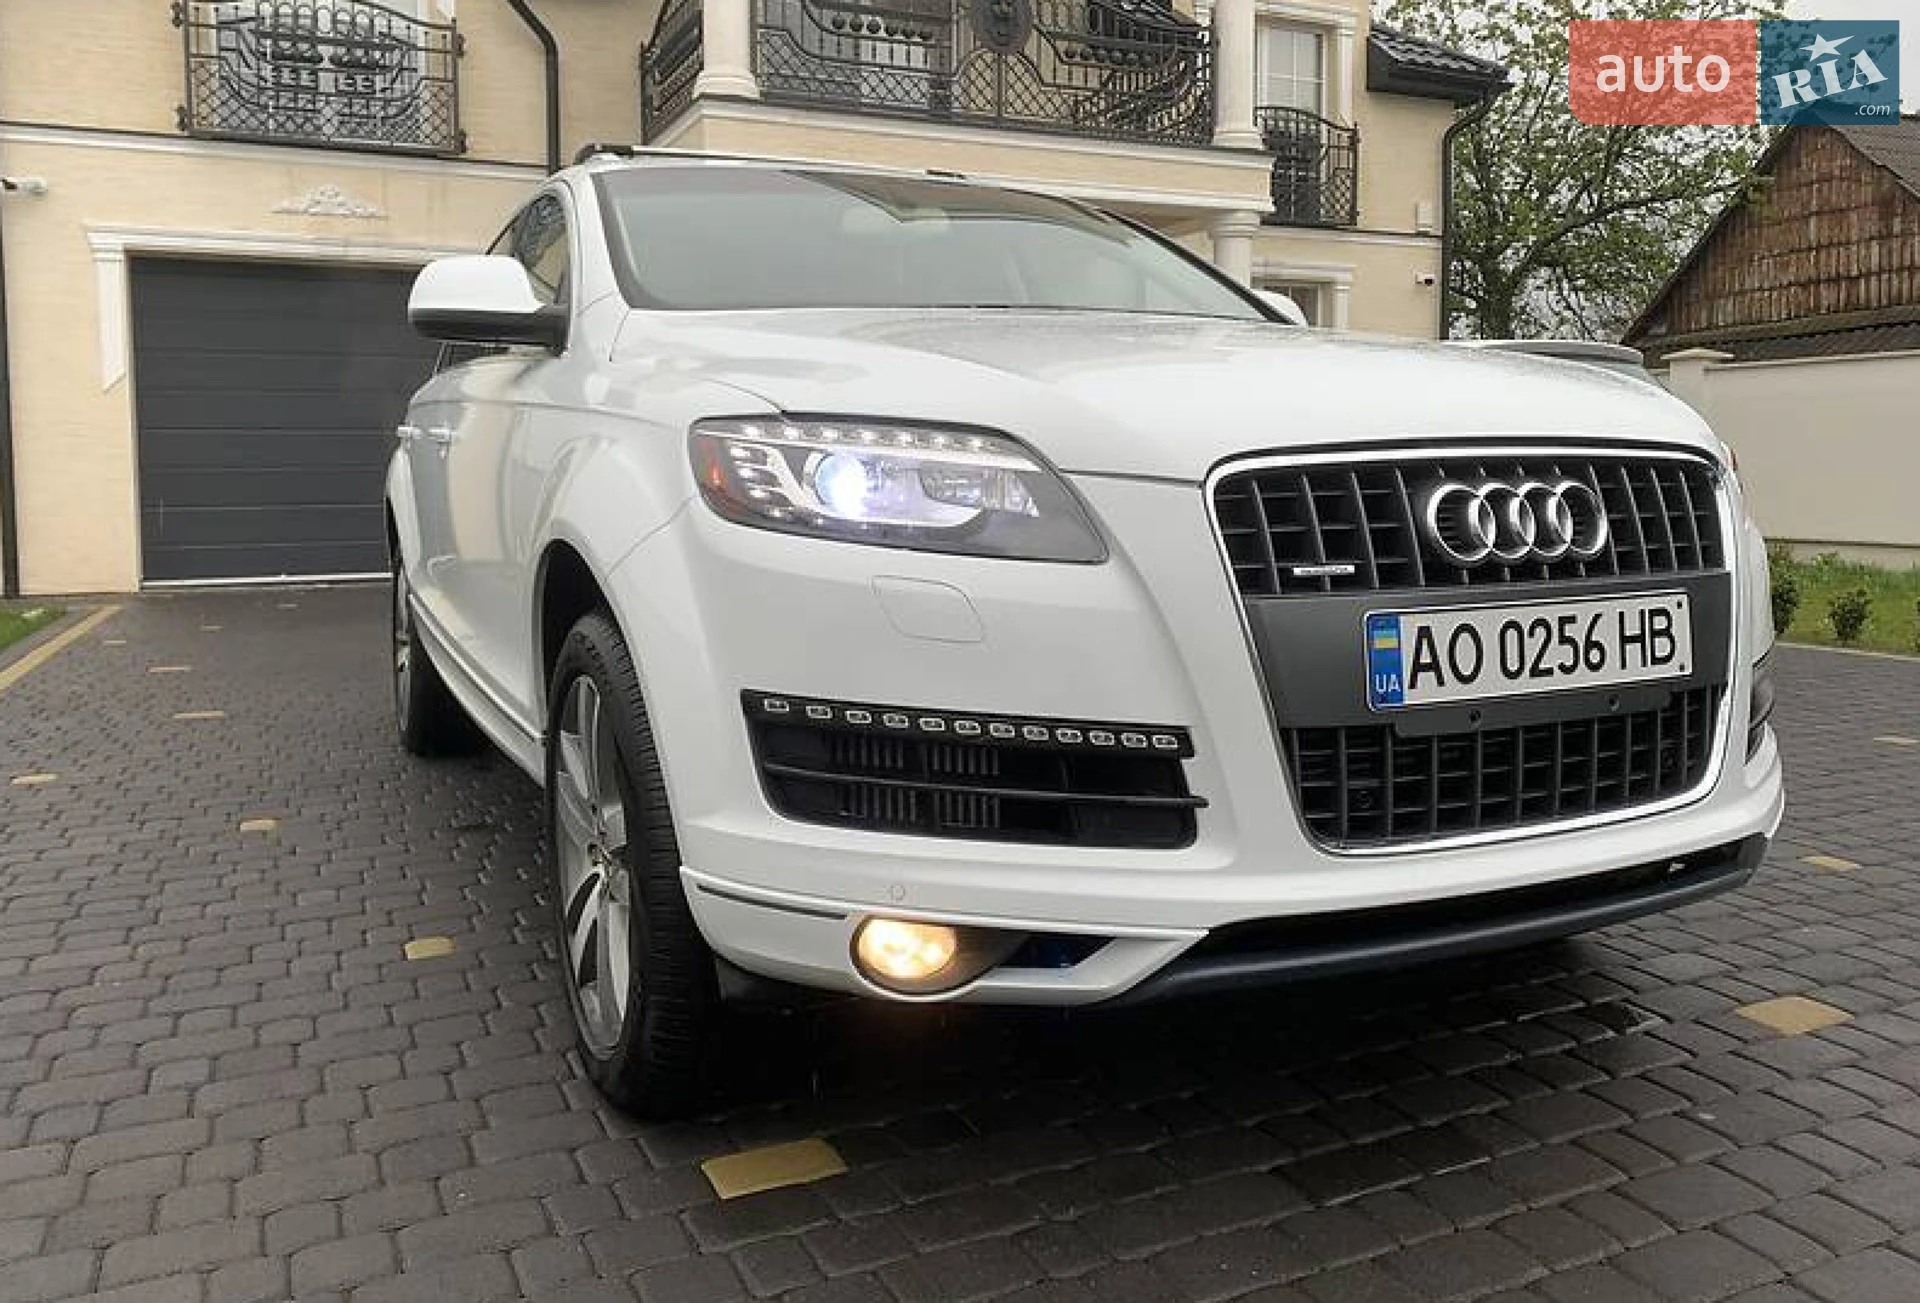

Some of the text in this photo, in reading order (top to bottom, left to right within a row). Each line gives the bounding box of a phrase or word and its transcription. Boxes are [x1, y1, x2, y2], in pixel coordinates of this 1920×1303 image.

[1407, 606, 1676, 690] AO 0256 HB
[1374, 673, 1402, 695] UA
